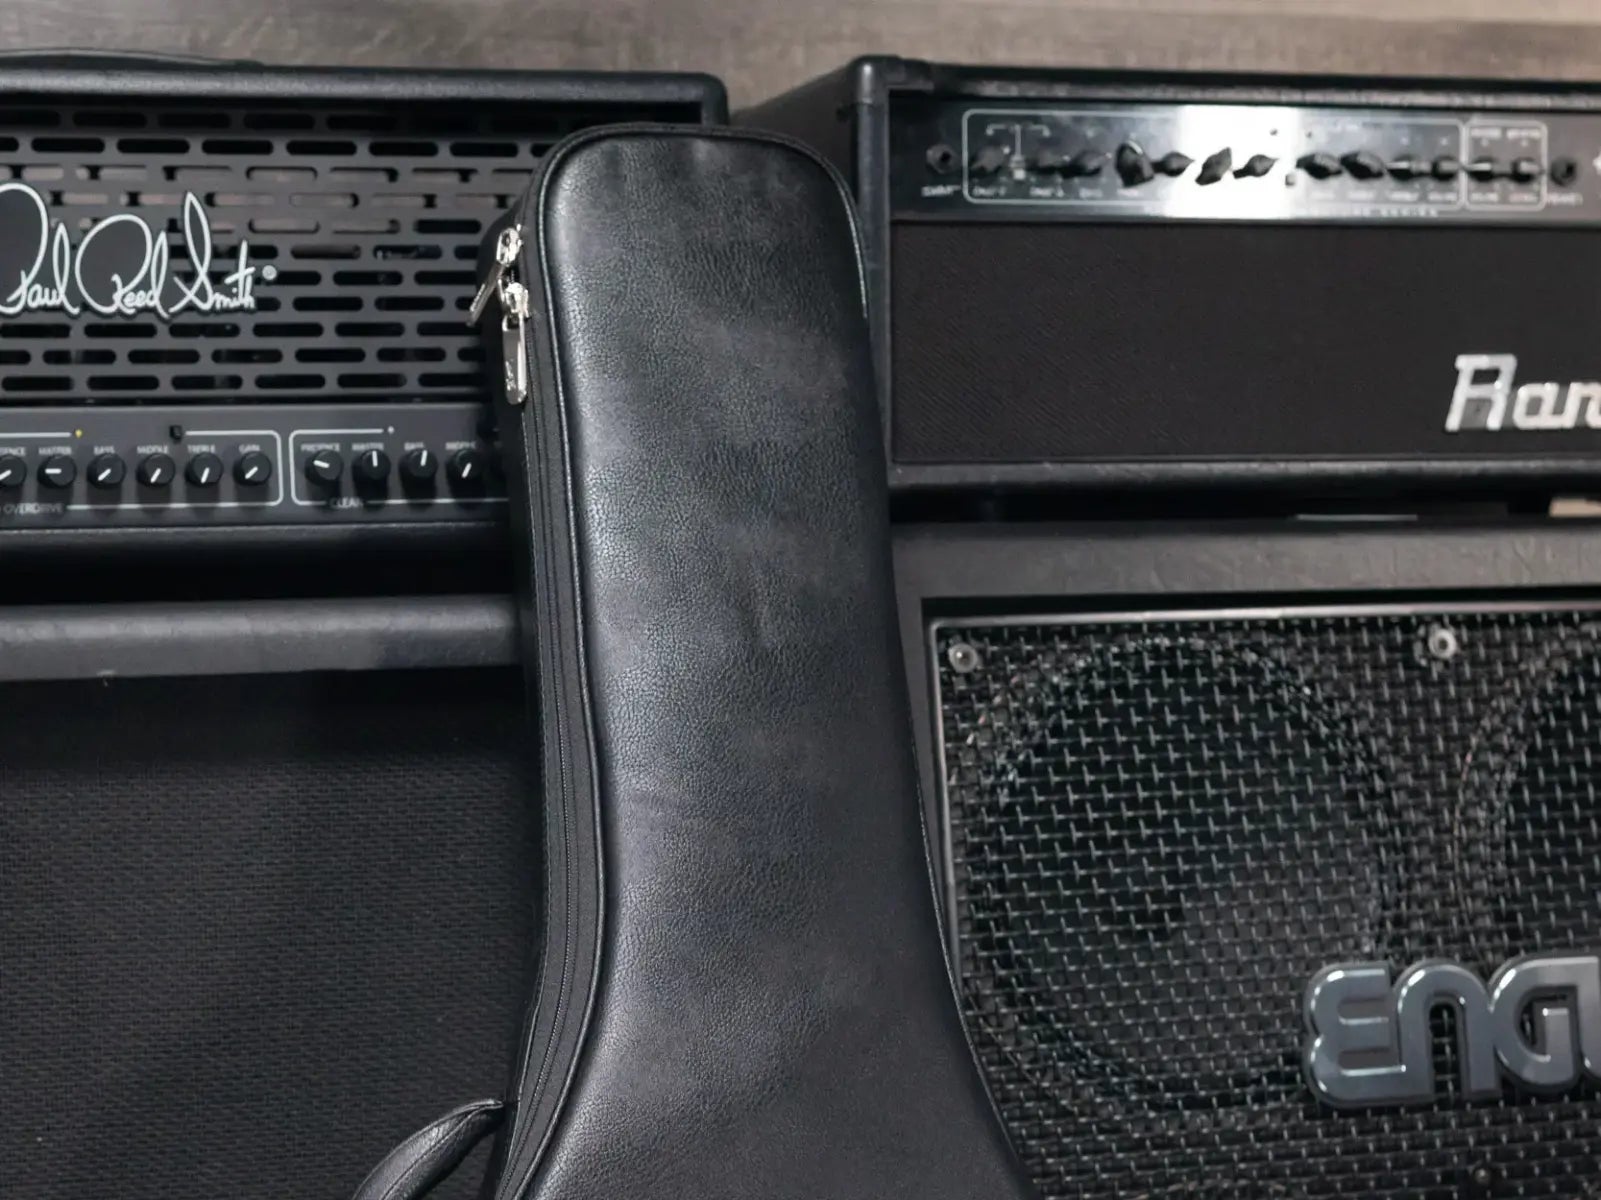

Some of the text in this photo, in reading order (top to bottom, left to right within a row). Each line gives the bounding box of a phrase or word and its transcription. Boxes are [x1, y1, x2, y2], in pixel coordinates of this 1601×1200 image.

[0, 182, 256, 319] Paul Reed Smith
